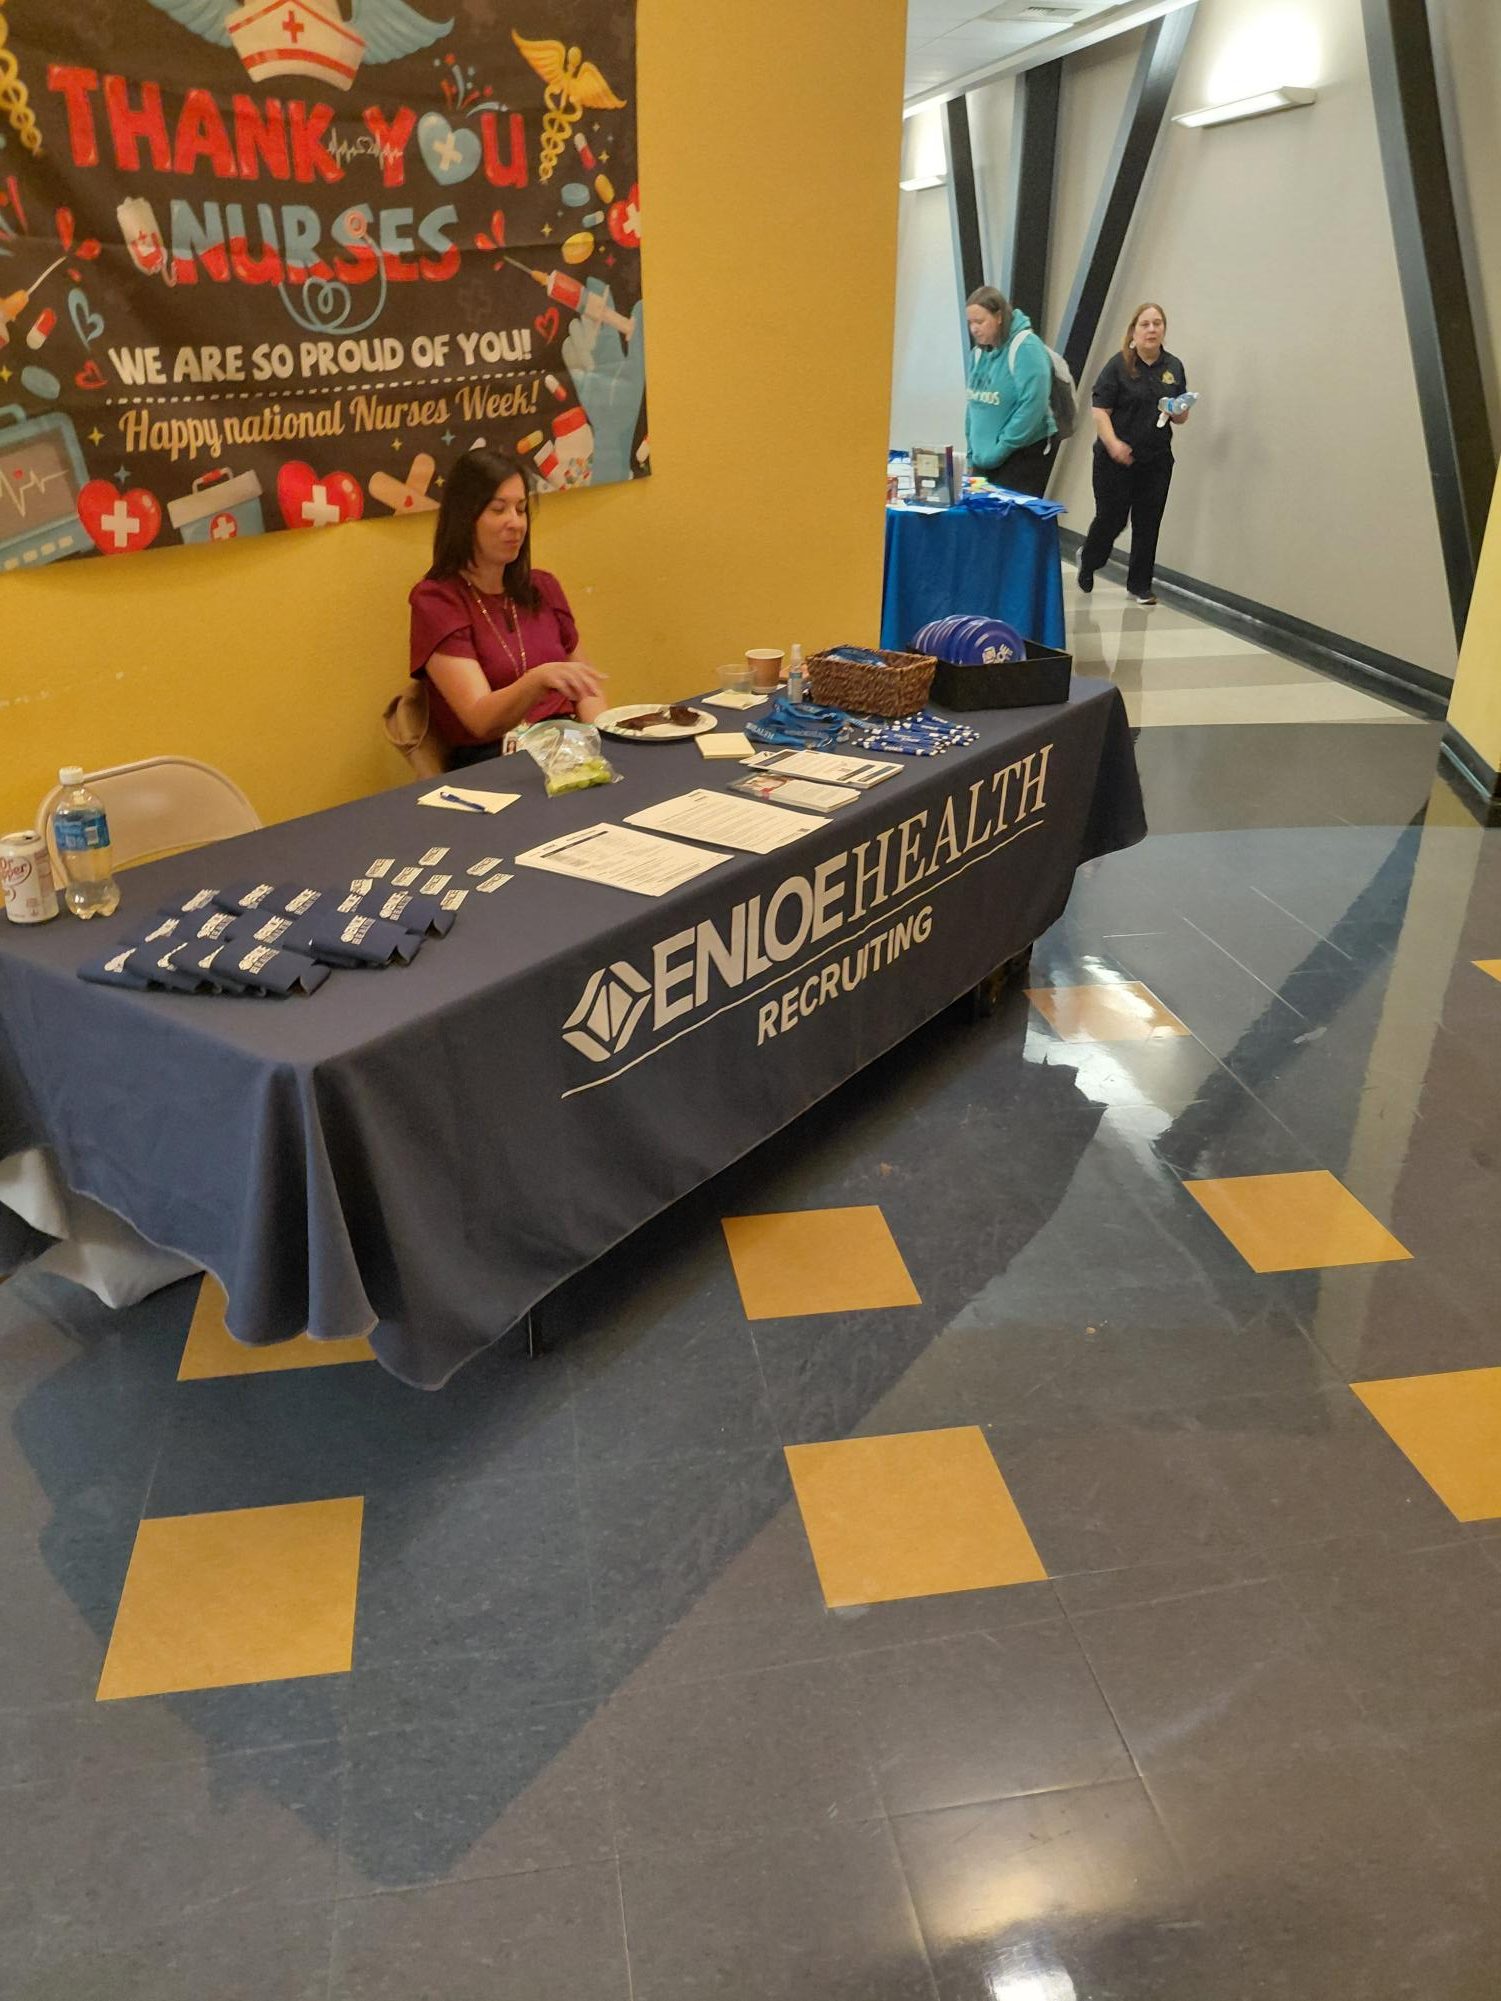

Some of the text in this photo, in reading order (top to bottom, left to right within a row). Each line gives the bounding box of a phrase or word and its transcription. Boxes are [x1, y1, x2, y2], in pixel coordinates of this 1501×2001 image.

[47, 64, 346, 184] THANK
[171, 199, 461, 285] NURSES
[108, 328, 532, 385] WE ARE SO PROUD OF YOU!
[118, 379, 540, 462] Happy national Nurses Week!
[756, 904, 933, 1046] RECRUITING
